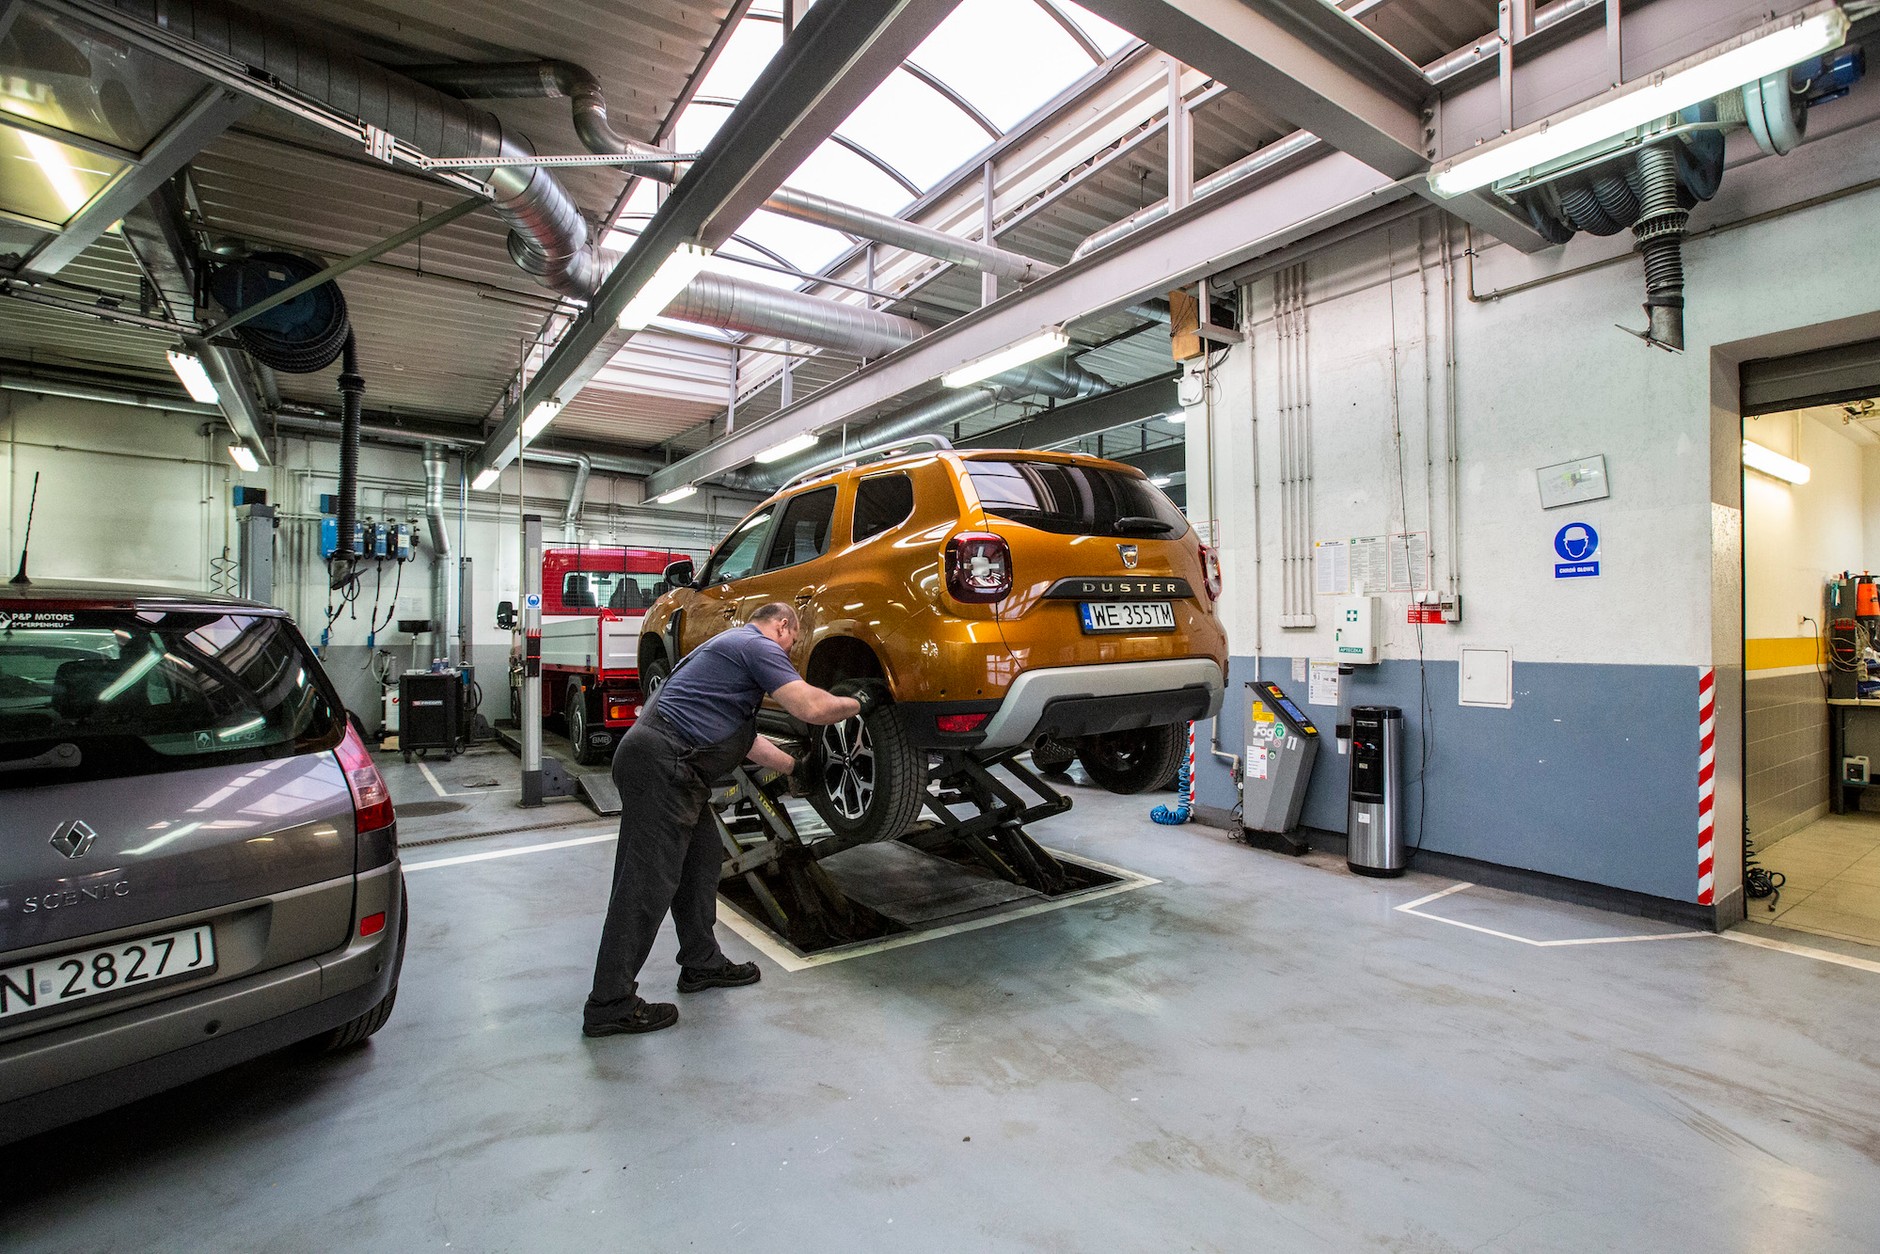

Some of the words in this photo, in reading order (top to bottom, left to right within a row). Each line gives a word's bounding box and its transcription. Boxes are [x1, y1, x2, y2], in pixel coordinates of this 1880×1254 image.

[1082, 582, 1176, 593] DUSTER
[12, 613, 32, 621] P&P
[34, 613, 75, 621] MOTORS
[1092, 604, 1120, 627] WE
[1122, 603, 1173, 626] 355TM
[22, 880, 130, 914] SCENIC
[0, 967, 37, 1014] N
